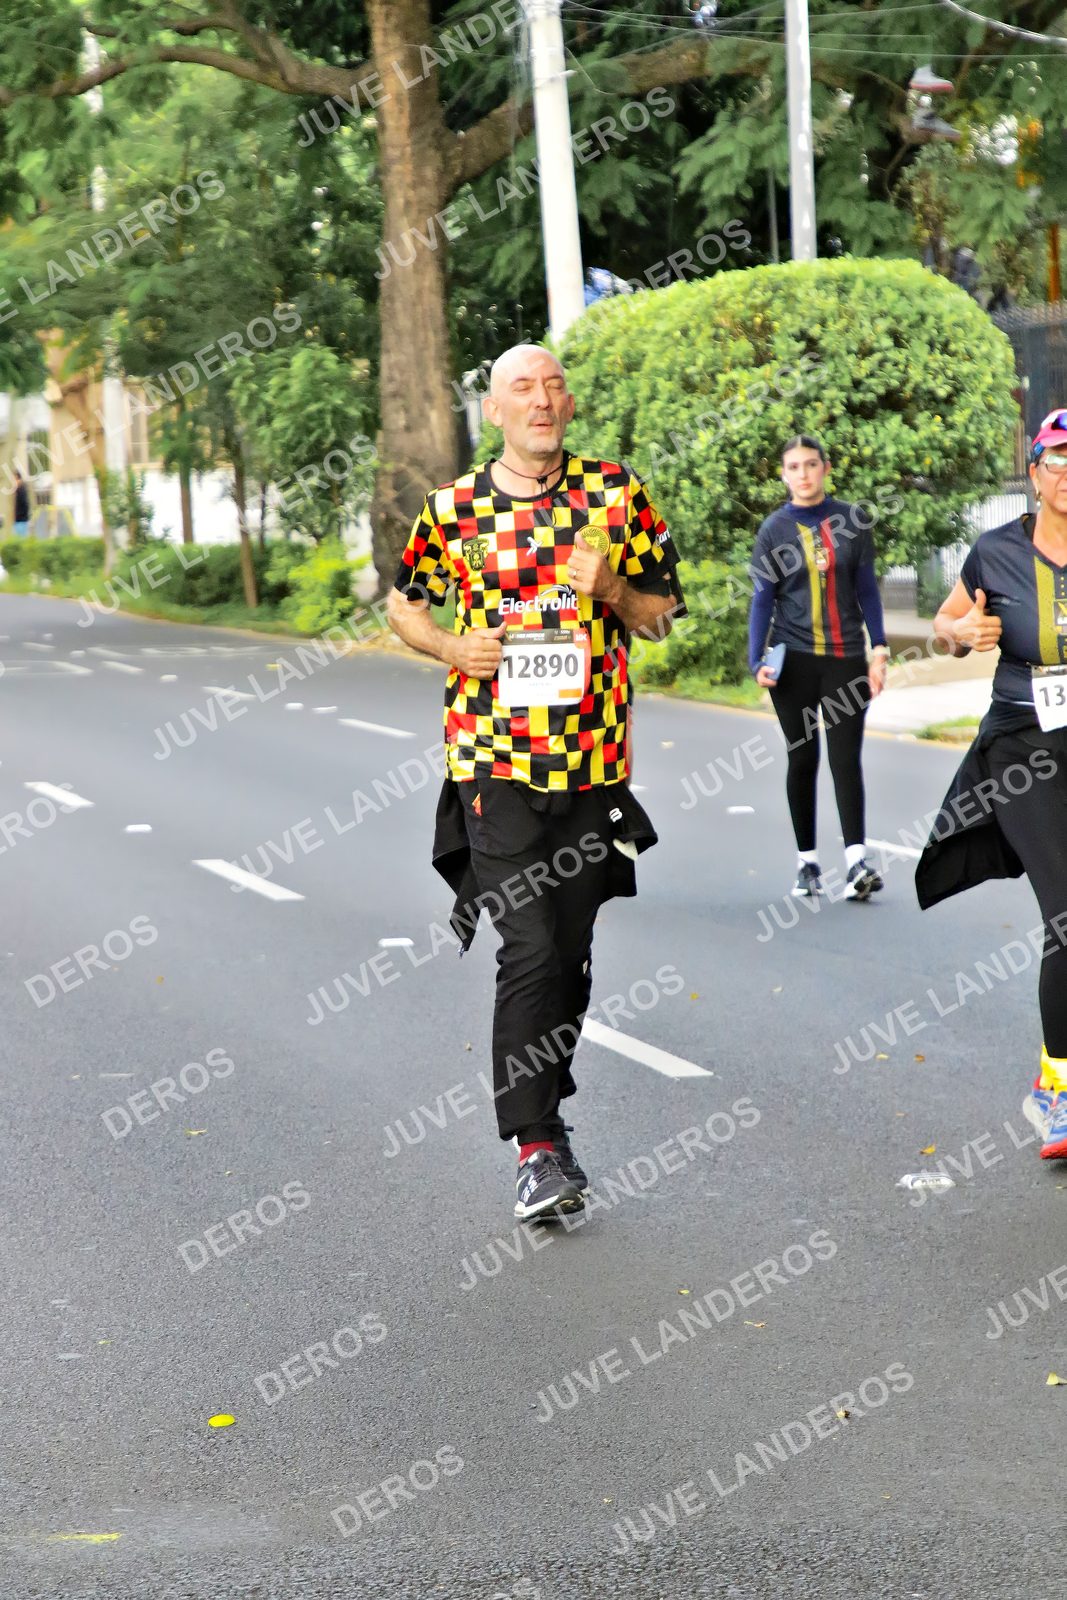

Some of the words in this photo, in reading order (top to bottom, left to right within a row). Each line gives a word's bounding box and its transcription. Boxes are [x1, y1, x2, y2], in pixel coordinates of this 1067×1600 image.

[498, 592, 578, 616] Electrolit
[503, 653, 579, 679] 12890
[1039, 684, 1066, 707] 13
